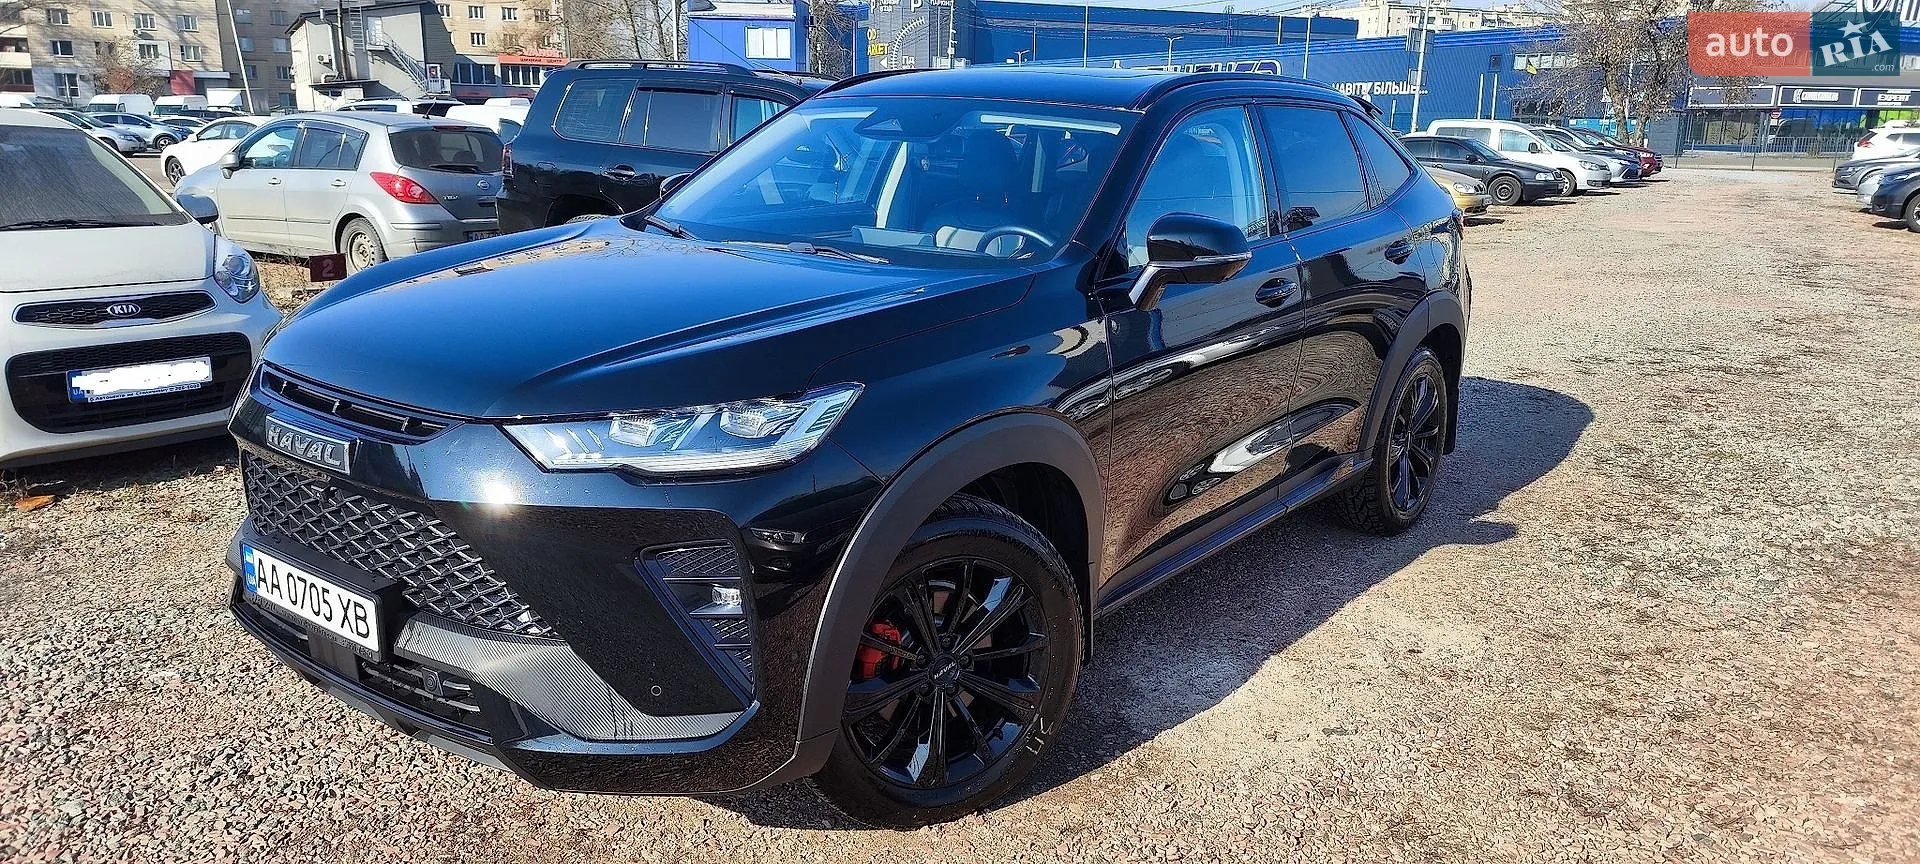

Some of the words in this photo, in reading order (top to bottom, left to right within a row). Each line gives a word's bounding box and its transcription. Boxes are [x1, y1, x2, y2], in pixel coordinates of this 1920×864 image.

[322, 258, 334, 277] 2
[113, 304, 137, 314] KIA
[268, 424, 342, 467] HAVAL
[257, 557, 283, 600] AA
[286, 572, 333, 622] 0705
[337, 593, 370, 639] XB
